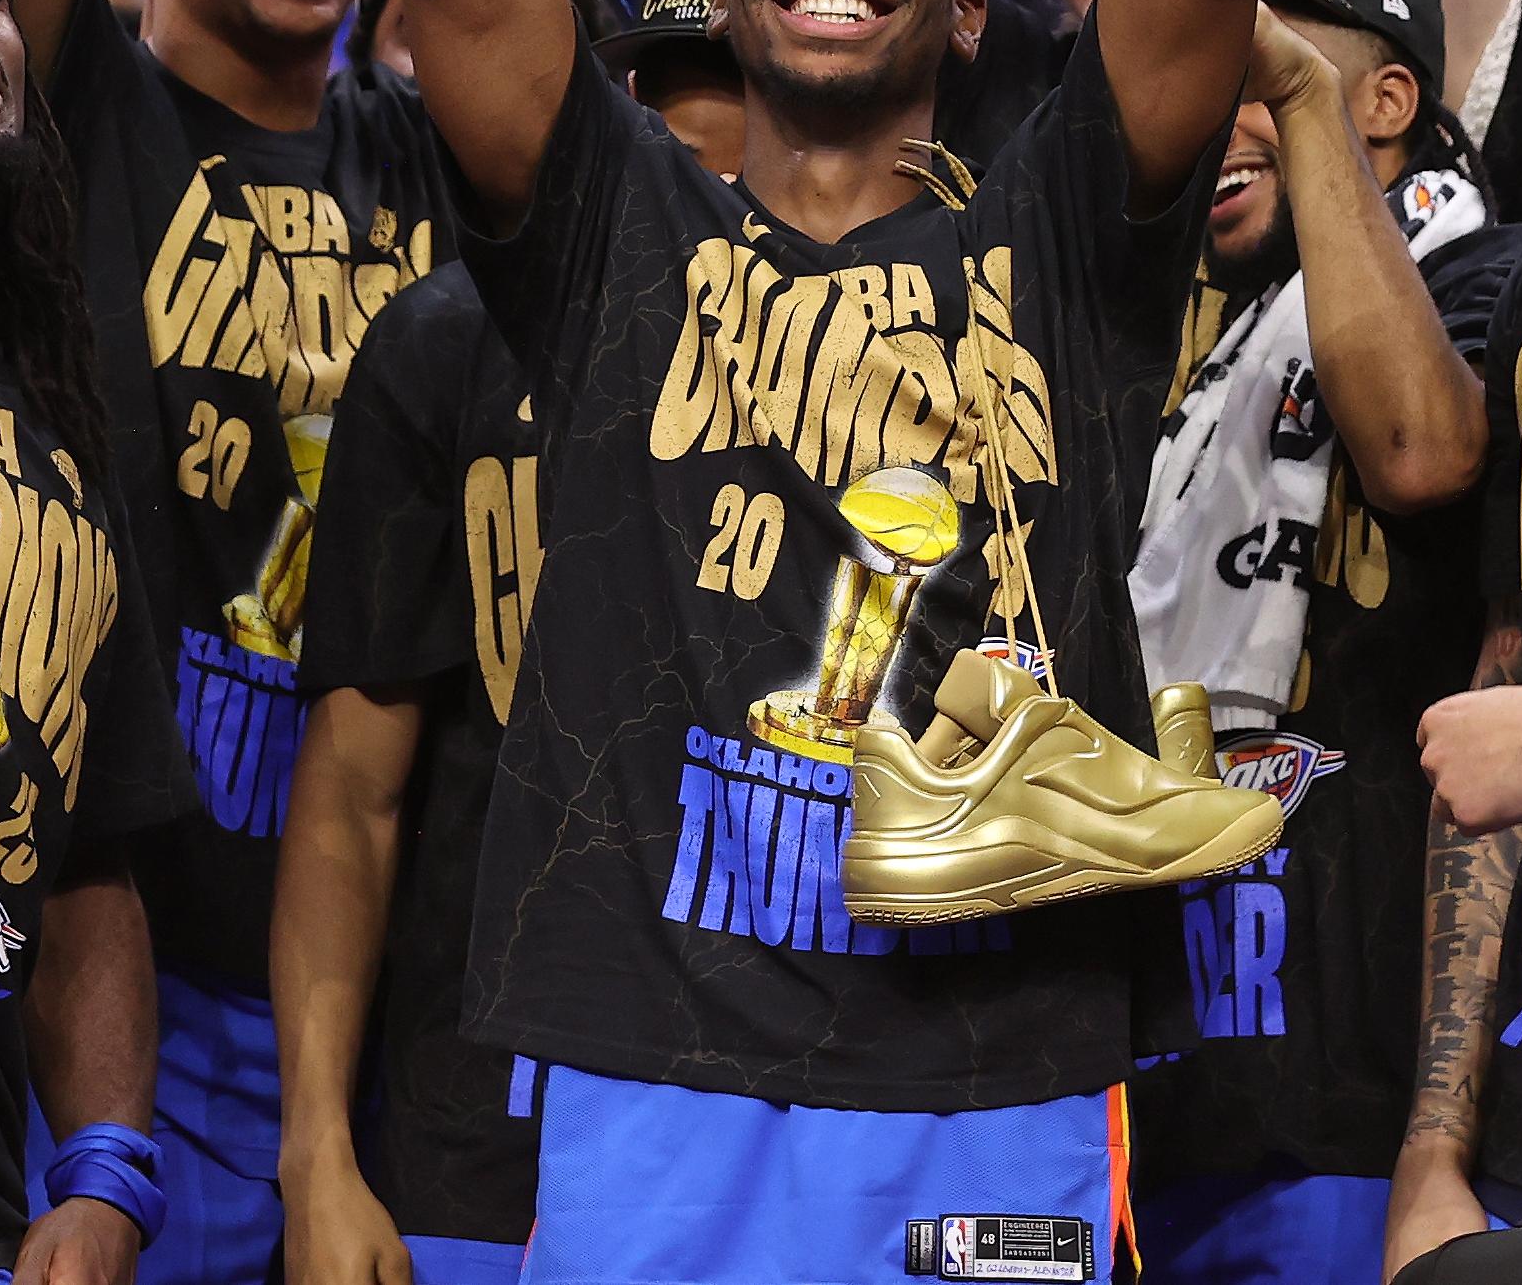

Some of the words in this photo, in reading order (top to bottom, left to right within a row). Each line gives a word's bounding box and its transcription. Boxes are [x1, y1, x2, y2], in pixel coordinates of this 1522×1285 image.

[829, 263, 936, 332] BA
[178, 399, 252, 512] 20
[695, 483, 785, 601] 20
[685, 725, 853, 799] OKLAHO
[661, 763, 1013, 956] THUN
[976, 1263, 983, 1273] 2
[980, 1233, 996, 1245] 48
